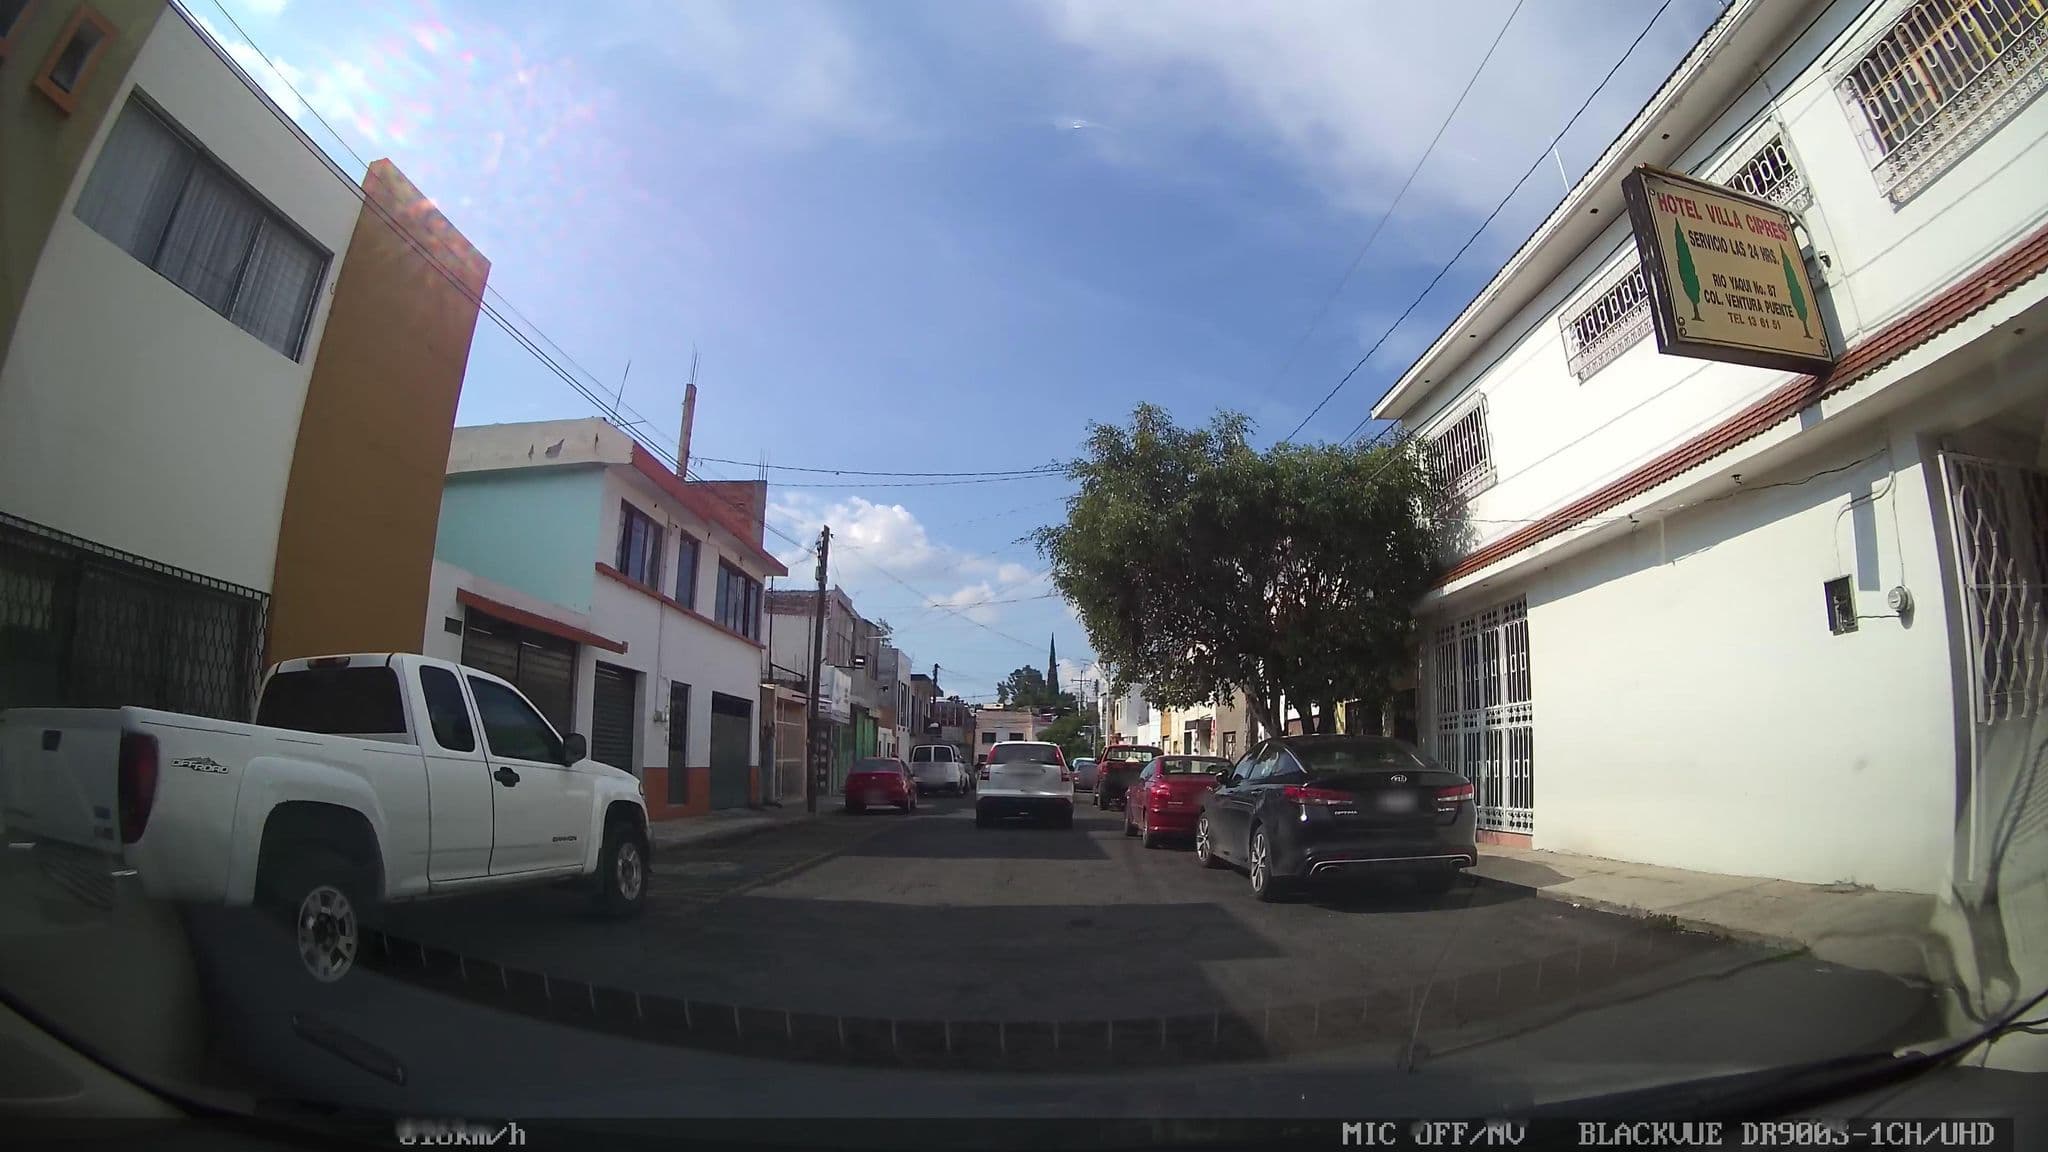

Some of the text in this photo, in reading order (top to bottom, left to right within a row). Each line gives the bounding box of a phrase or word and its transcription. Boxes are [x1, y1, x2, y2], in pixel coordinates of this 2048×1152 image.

[1657, 192, 1788, 242] HOTEL VILLA CIPRES
[1688, 229, 1780, 265] SERVICIO LAS 24 HRS.
[1712, 273, 1727, 288] RIO
[1729, 276, 1753, 293] YAQUI
[1704, 289, 1795, 318] COL. VENTURA PUENTE
[1728, 312, 1745, 325] TEL
[1748, 315, 1757, 327] 13
